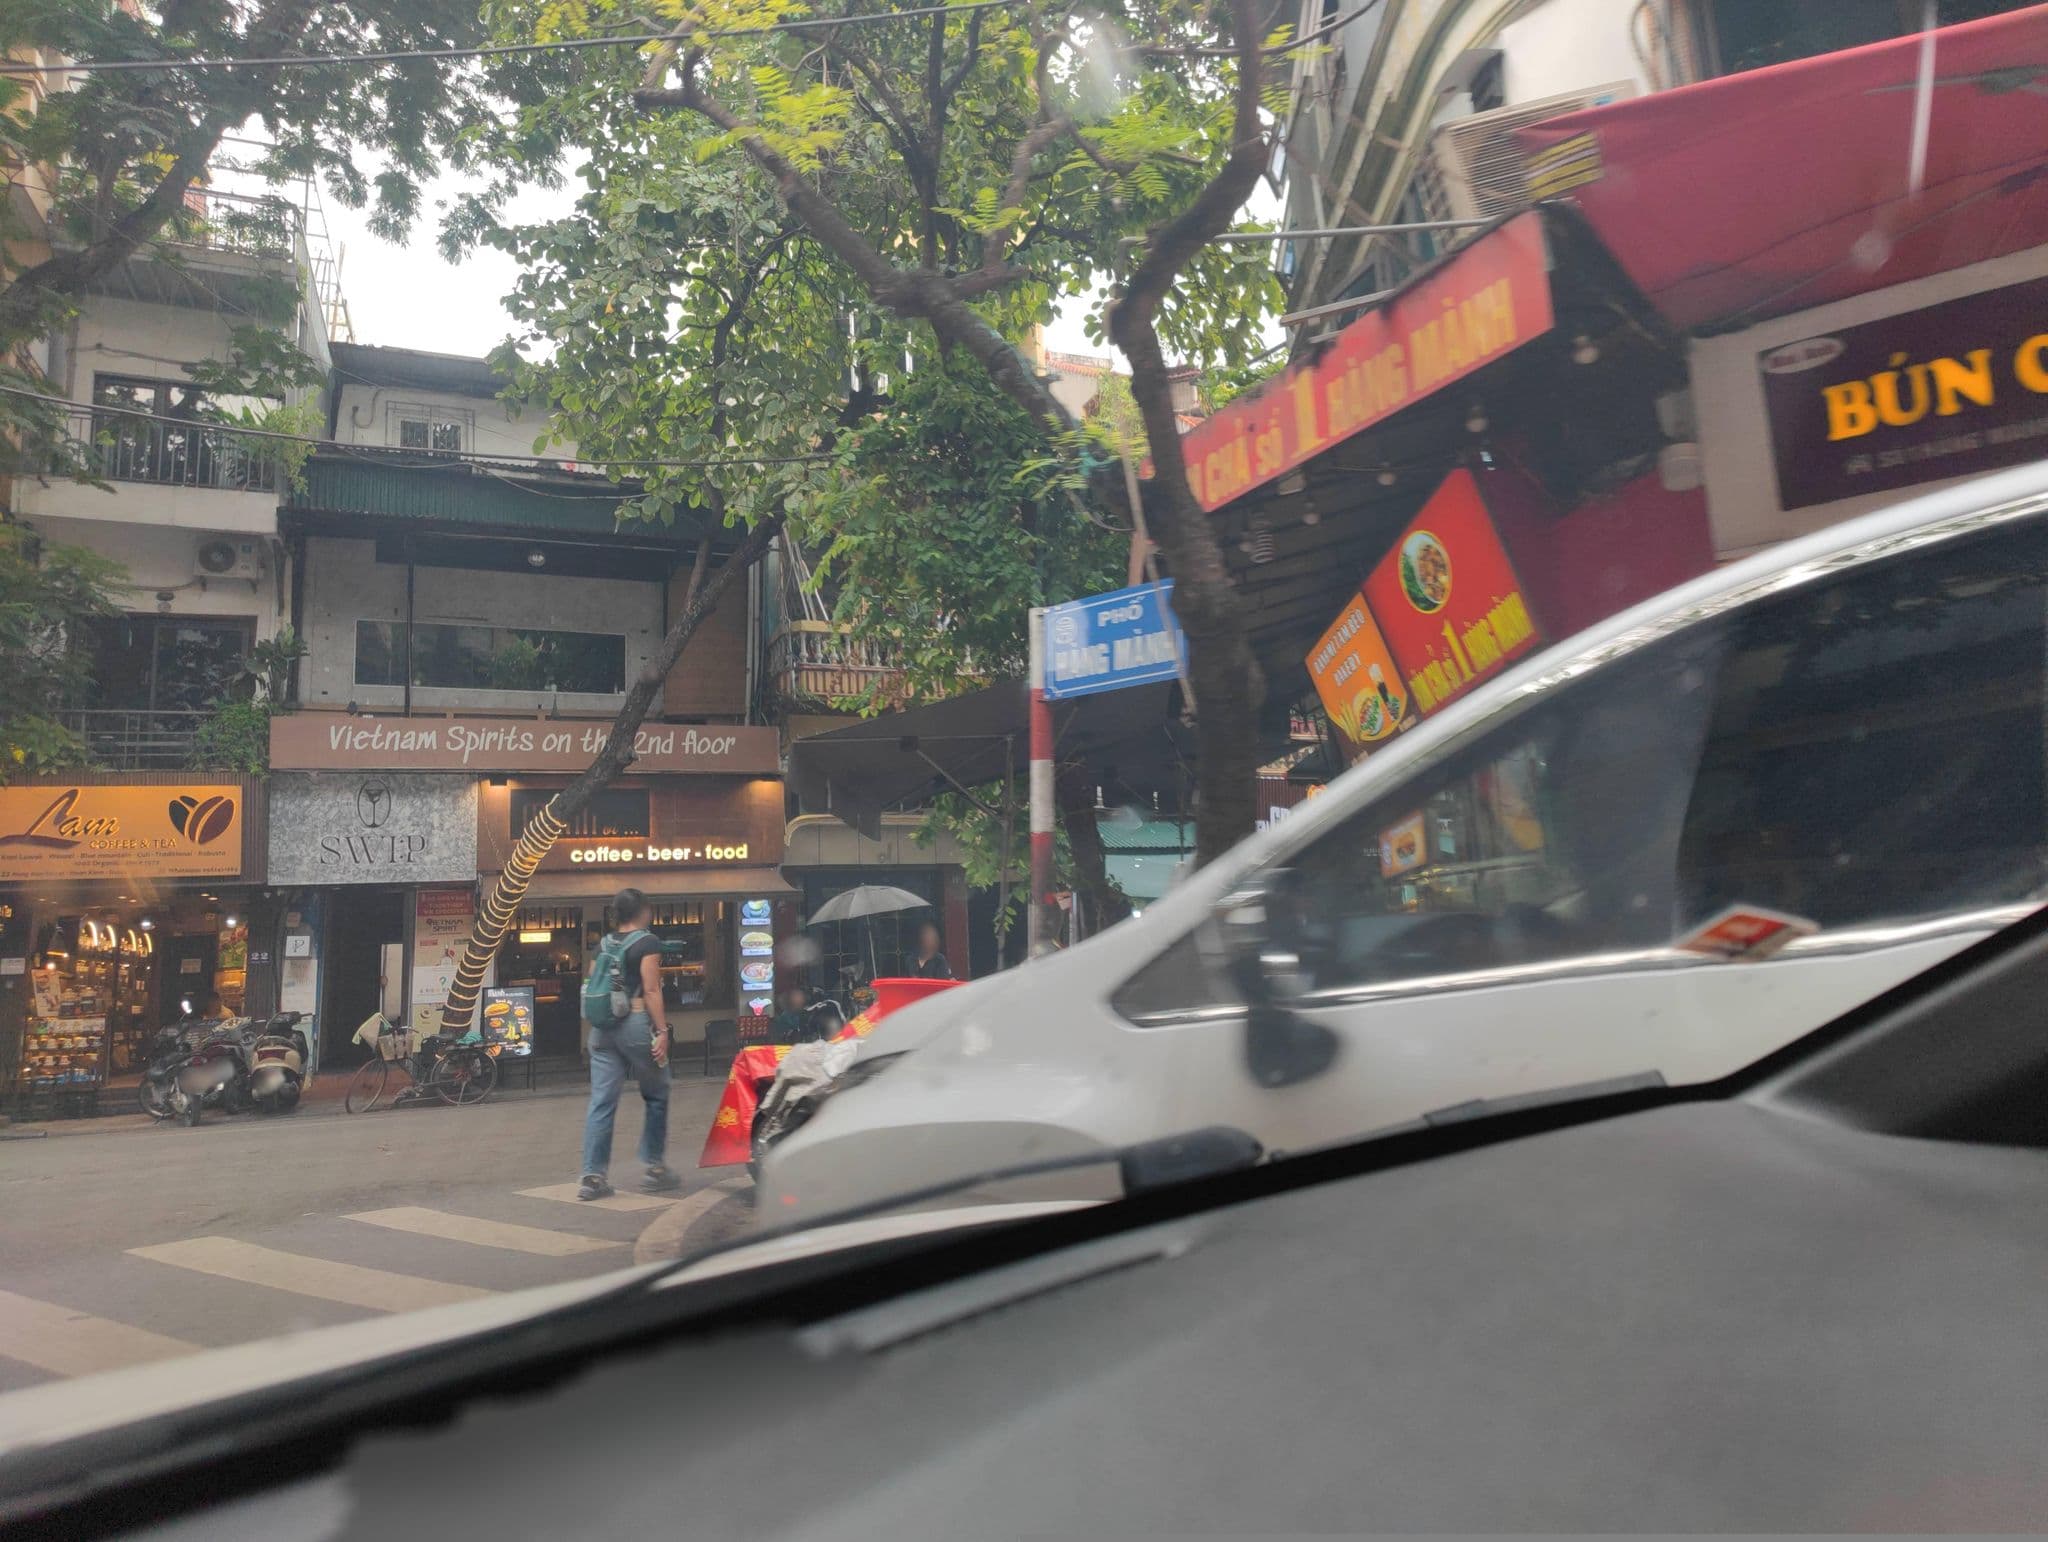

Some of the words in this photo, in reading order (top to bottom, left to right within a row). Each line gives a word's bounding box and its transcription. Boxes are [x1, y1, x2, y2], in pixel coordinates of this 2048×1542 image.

[1286, 367, 1327, 458] 1
[1822, 349, 1993, 441] BÚN
[329, 724, 437, 751] Vietnam
[446, 725, 533, 764] Spirits
[542, 732, 572, 753] on
[634, 731, 674, 755] 2nd
[681, 729, 736, 755] floor
[90, 840, 138, 849] COFFEE
[140, 840, 150, 849] &
[153, 839, 177, 849] TEA
[570, 845, 633, 863] coffee
[647, 845, 691, 862] beer
[705, 843, 749, 860] food
